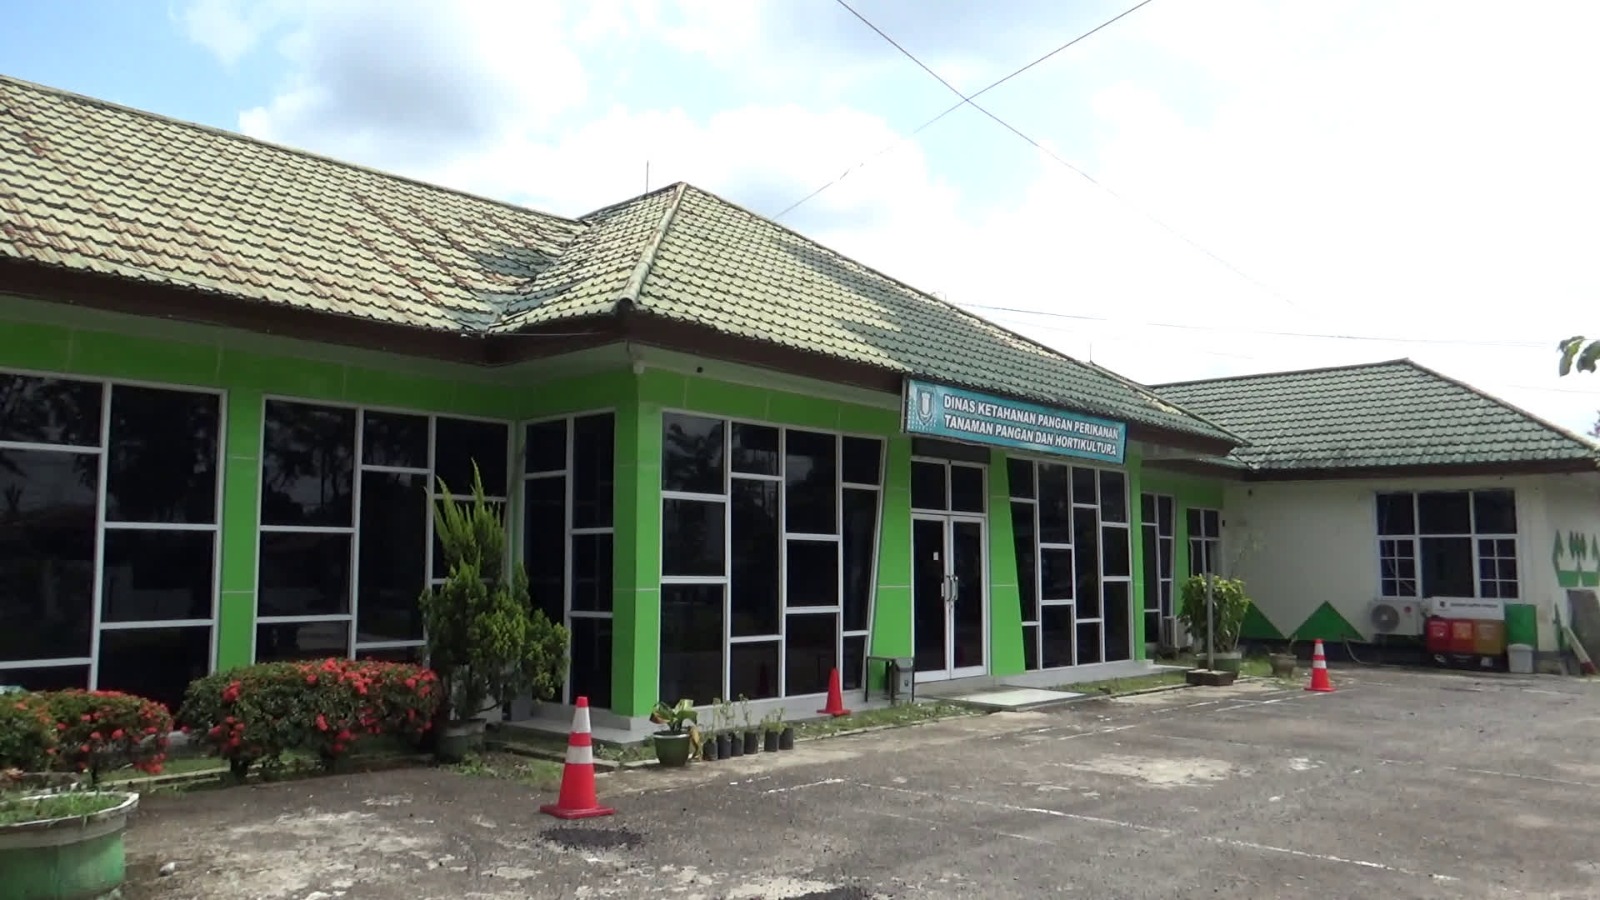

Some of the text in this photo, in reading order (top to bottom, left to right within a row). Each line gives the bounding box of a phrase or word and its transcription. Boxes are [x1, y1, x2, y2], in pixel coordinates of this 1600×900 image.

[944, 395, 1118, 439] DINAS KETAHANAN PANGAN PERIKANAN
[944, 414, 1117, 455] TANAMAN PANGAN DAN HORTIKULTURA
